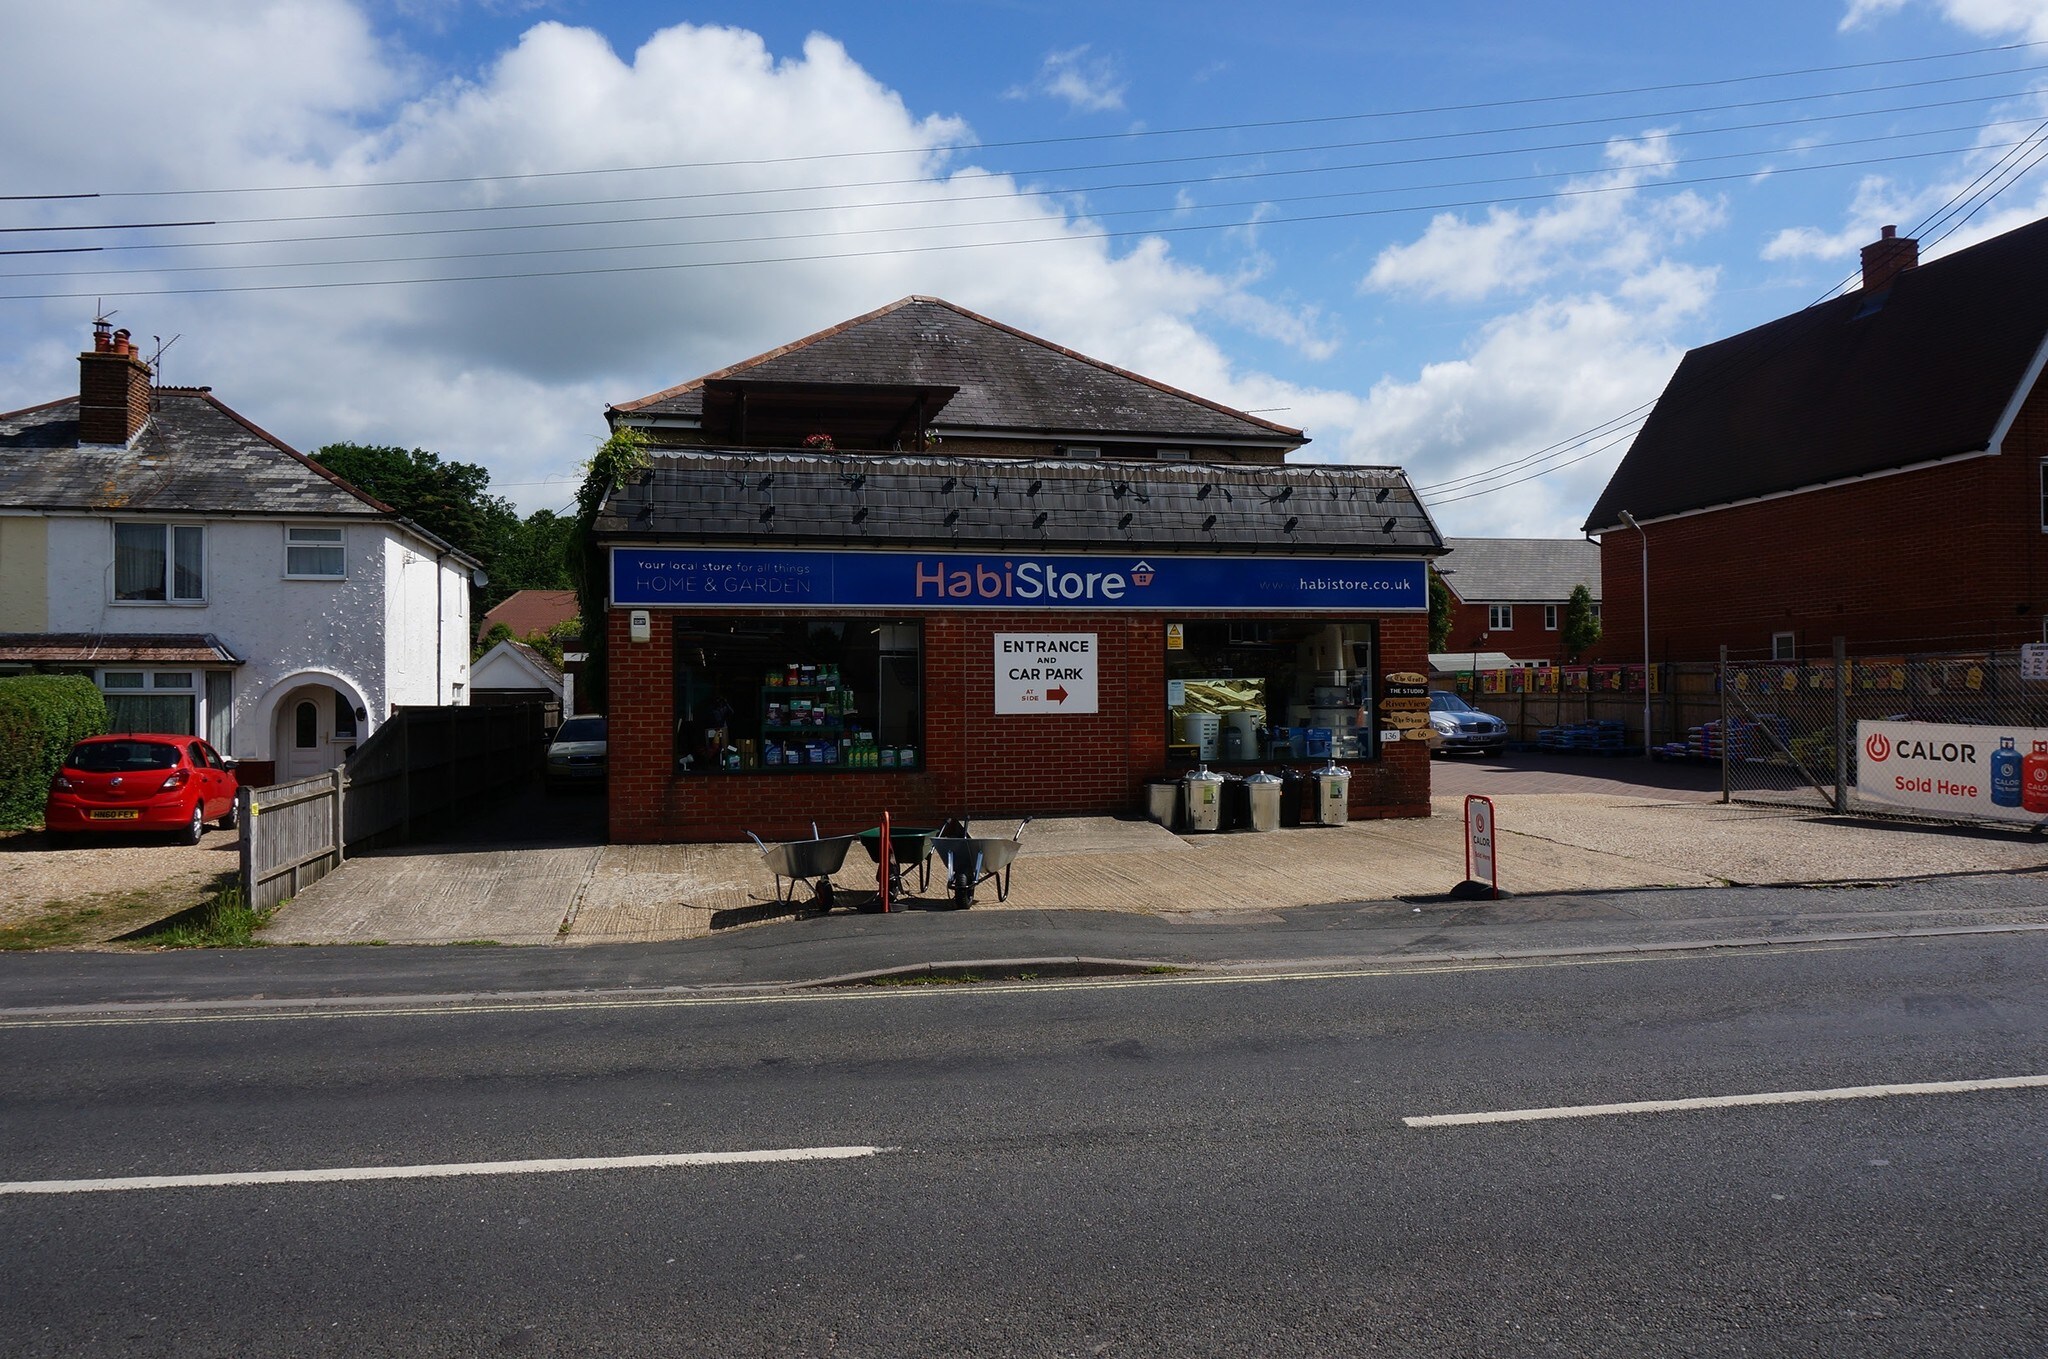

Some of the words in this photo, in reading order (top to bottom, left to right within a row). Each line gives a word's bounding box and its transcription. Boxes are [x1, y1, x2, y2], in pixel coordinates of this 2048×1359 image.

[638, 560, 665, 570] Your
[669, 560, 698, 571] local
[702, 562, 733, 572] store
[737, 562, 753, 573] for
[757, 562, 770, 573] all
[773, 563, 810, 575] things
[636, 576, 697, 592] HOME
[704, 576, 718, 592] &
[724, 577, 811, 593] GARDEN
[915, 560, 1126, 599] HabiStore
[1003, 640, 1089, 653] ENTRANCE
[1008, 668, 1041, 680] CAR
[1045, 668, 1083, 680] PARK
[1384, 732, 1397, 740] 136
[1896, 740, 1976, 763] CALOR
[1895, 776, 1932, 793] Sold
[1937, 780, 1978, 797] Here
[1995, 778, 2021, 786] CALOR
